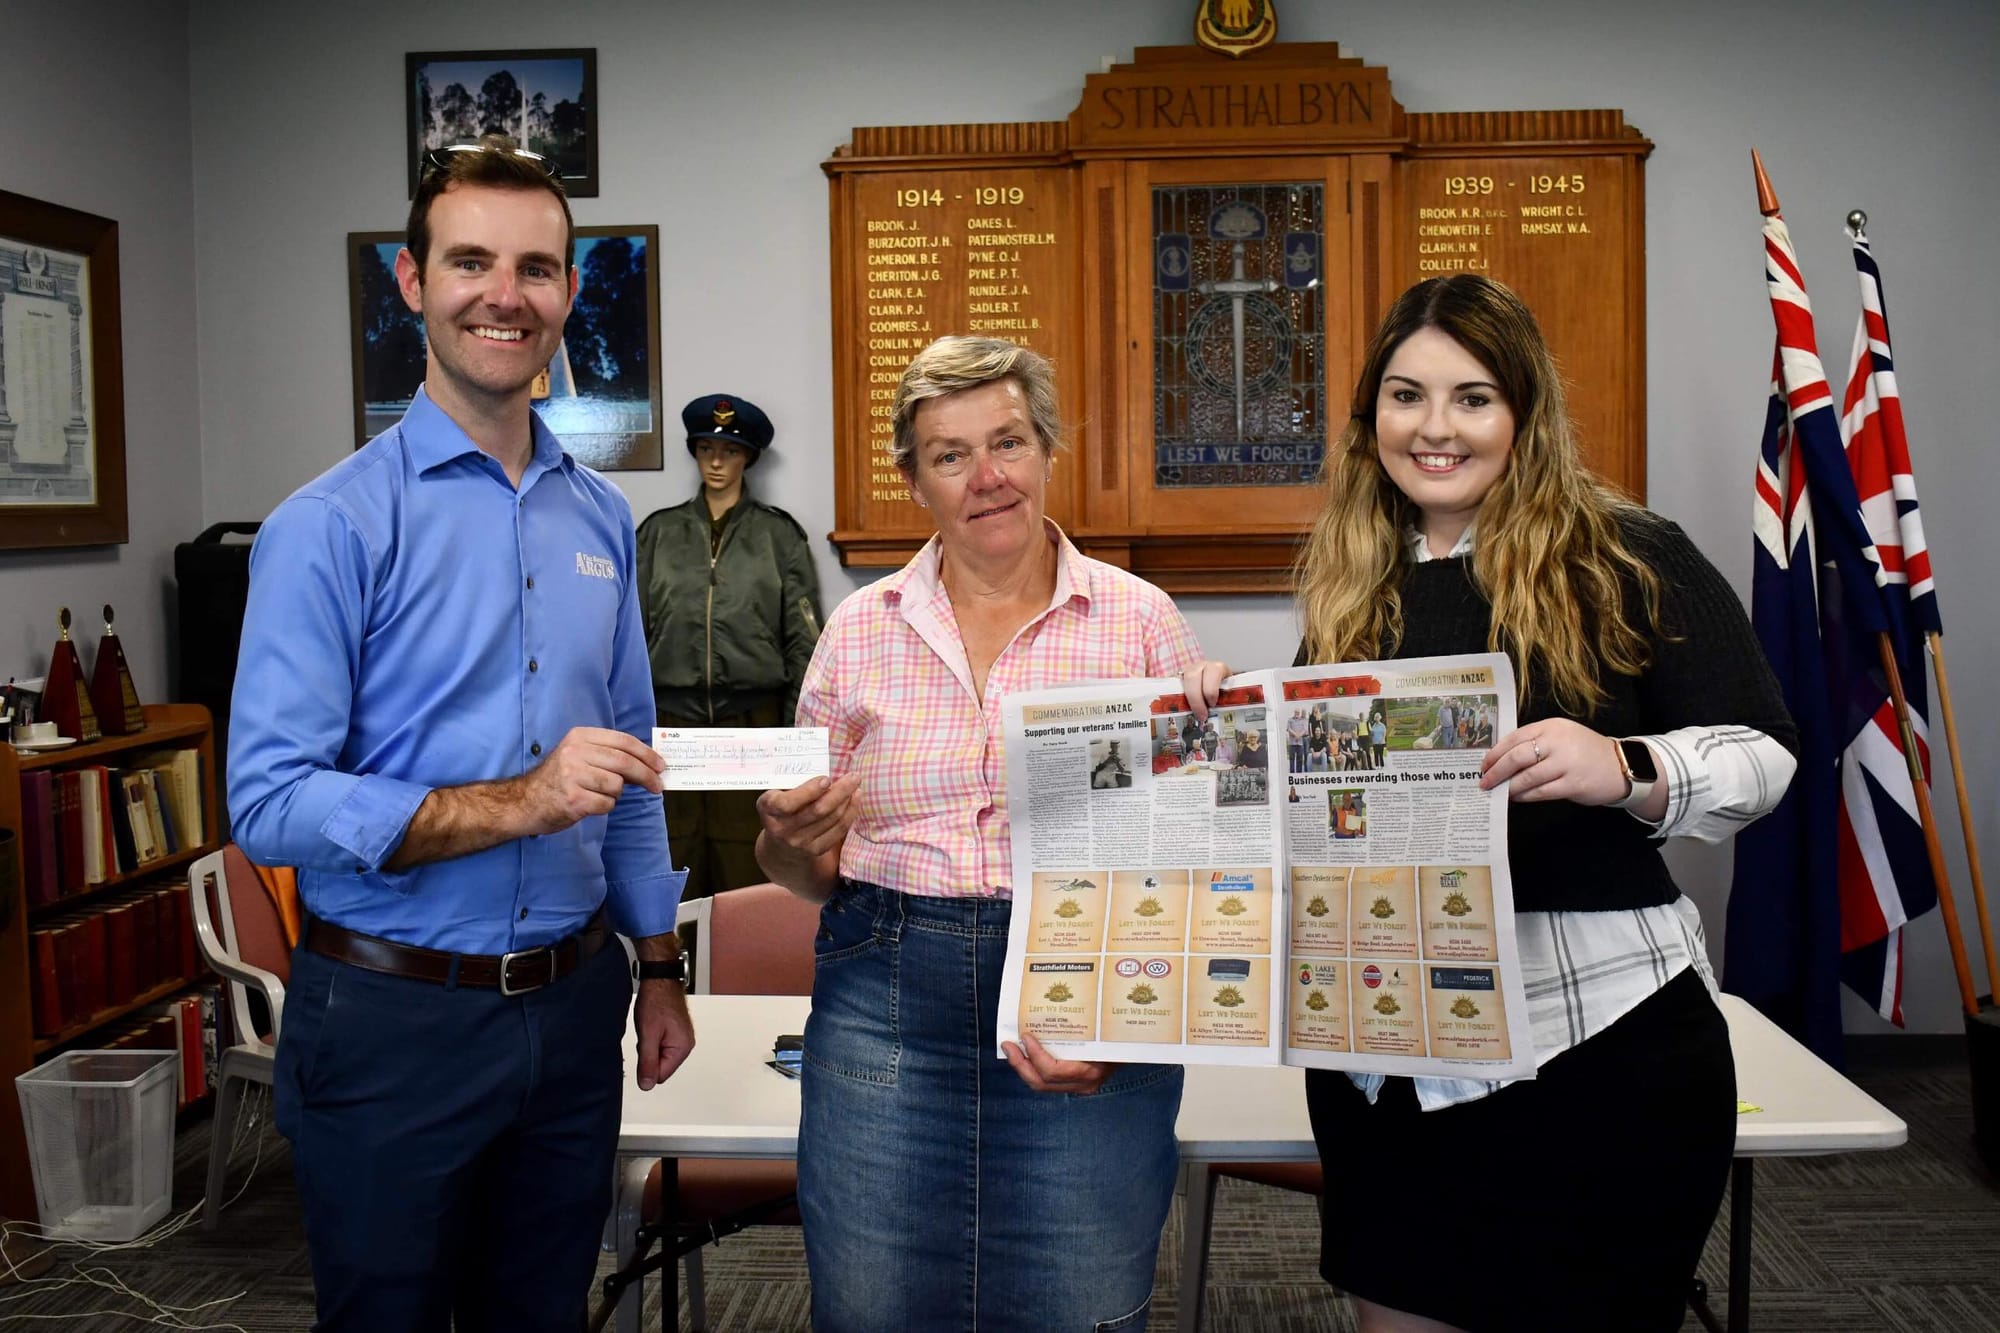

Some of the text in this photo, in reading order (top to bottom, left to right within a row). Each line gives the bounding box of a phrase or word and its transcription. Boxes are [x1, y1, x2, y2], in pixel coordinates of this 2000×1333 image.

[1101, 82, 1373, 129] STRATHALBYN
[1445, 176, 1494, 195] 1939
[1530, 175, 1586, 194] 1945
[897, 190, 944, 208] 1914
[975, 187, 1025, 205] 1919
[1168, 445, 1315, 462] LEST WE FORGET
[576, 552, 615, 579] ARGUS
[1396, 672, 1486, 688] COMMEMORATING ANZAC
[1032, 703, 1133, 720] COMMEMORATING ANZAC
[1024, 725, 1065, 738] Supporting
[1067, 725, 1080, 734] our
[1118, 719, 1148, 730] families
[1288, 774, 1342, 785] Businesses
[1345, 772, 1398, 784] rewarding
[1400, 772, 1430, 782] those
[1433, 771, 1456, 781] who
